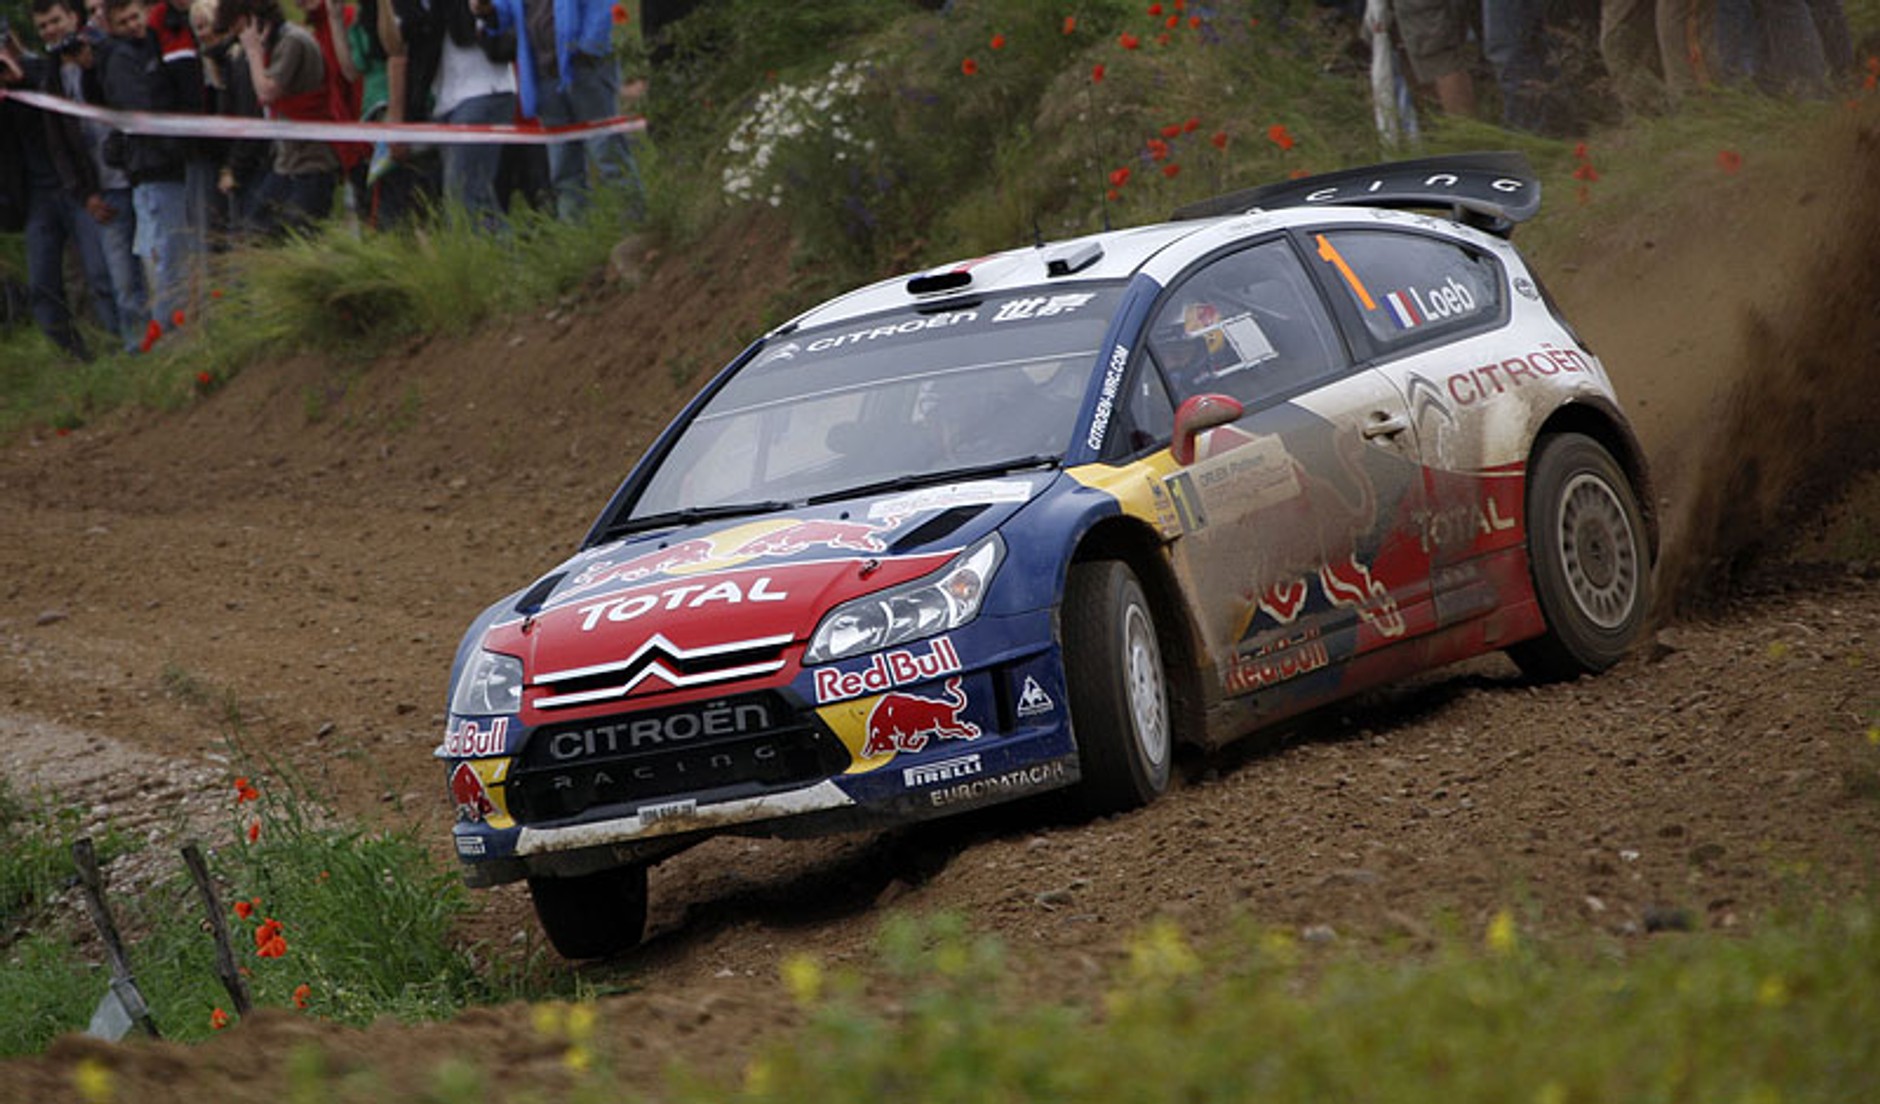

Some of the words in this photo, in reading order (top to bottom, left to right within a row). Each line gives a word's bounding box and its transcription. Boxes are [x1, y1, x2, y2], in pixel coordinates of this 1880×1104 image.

[1316, 233, 1377, 311] 1
[1409, 275, 1476, 321] Loeb
[1087, 344, 1130, 450] CITROEN-WRC.COM
[577, 577, 788, 631] TOTAL
[814, 654, 889, 704] Red
[887, 635, 962, 684] Bull
[462, 716, 508, 757] Bull
[903, 754, 983, 787] PIRELLI
